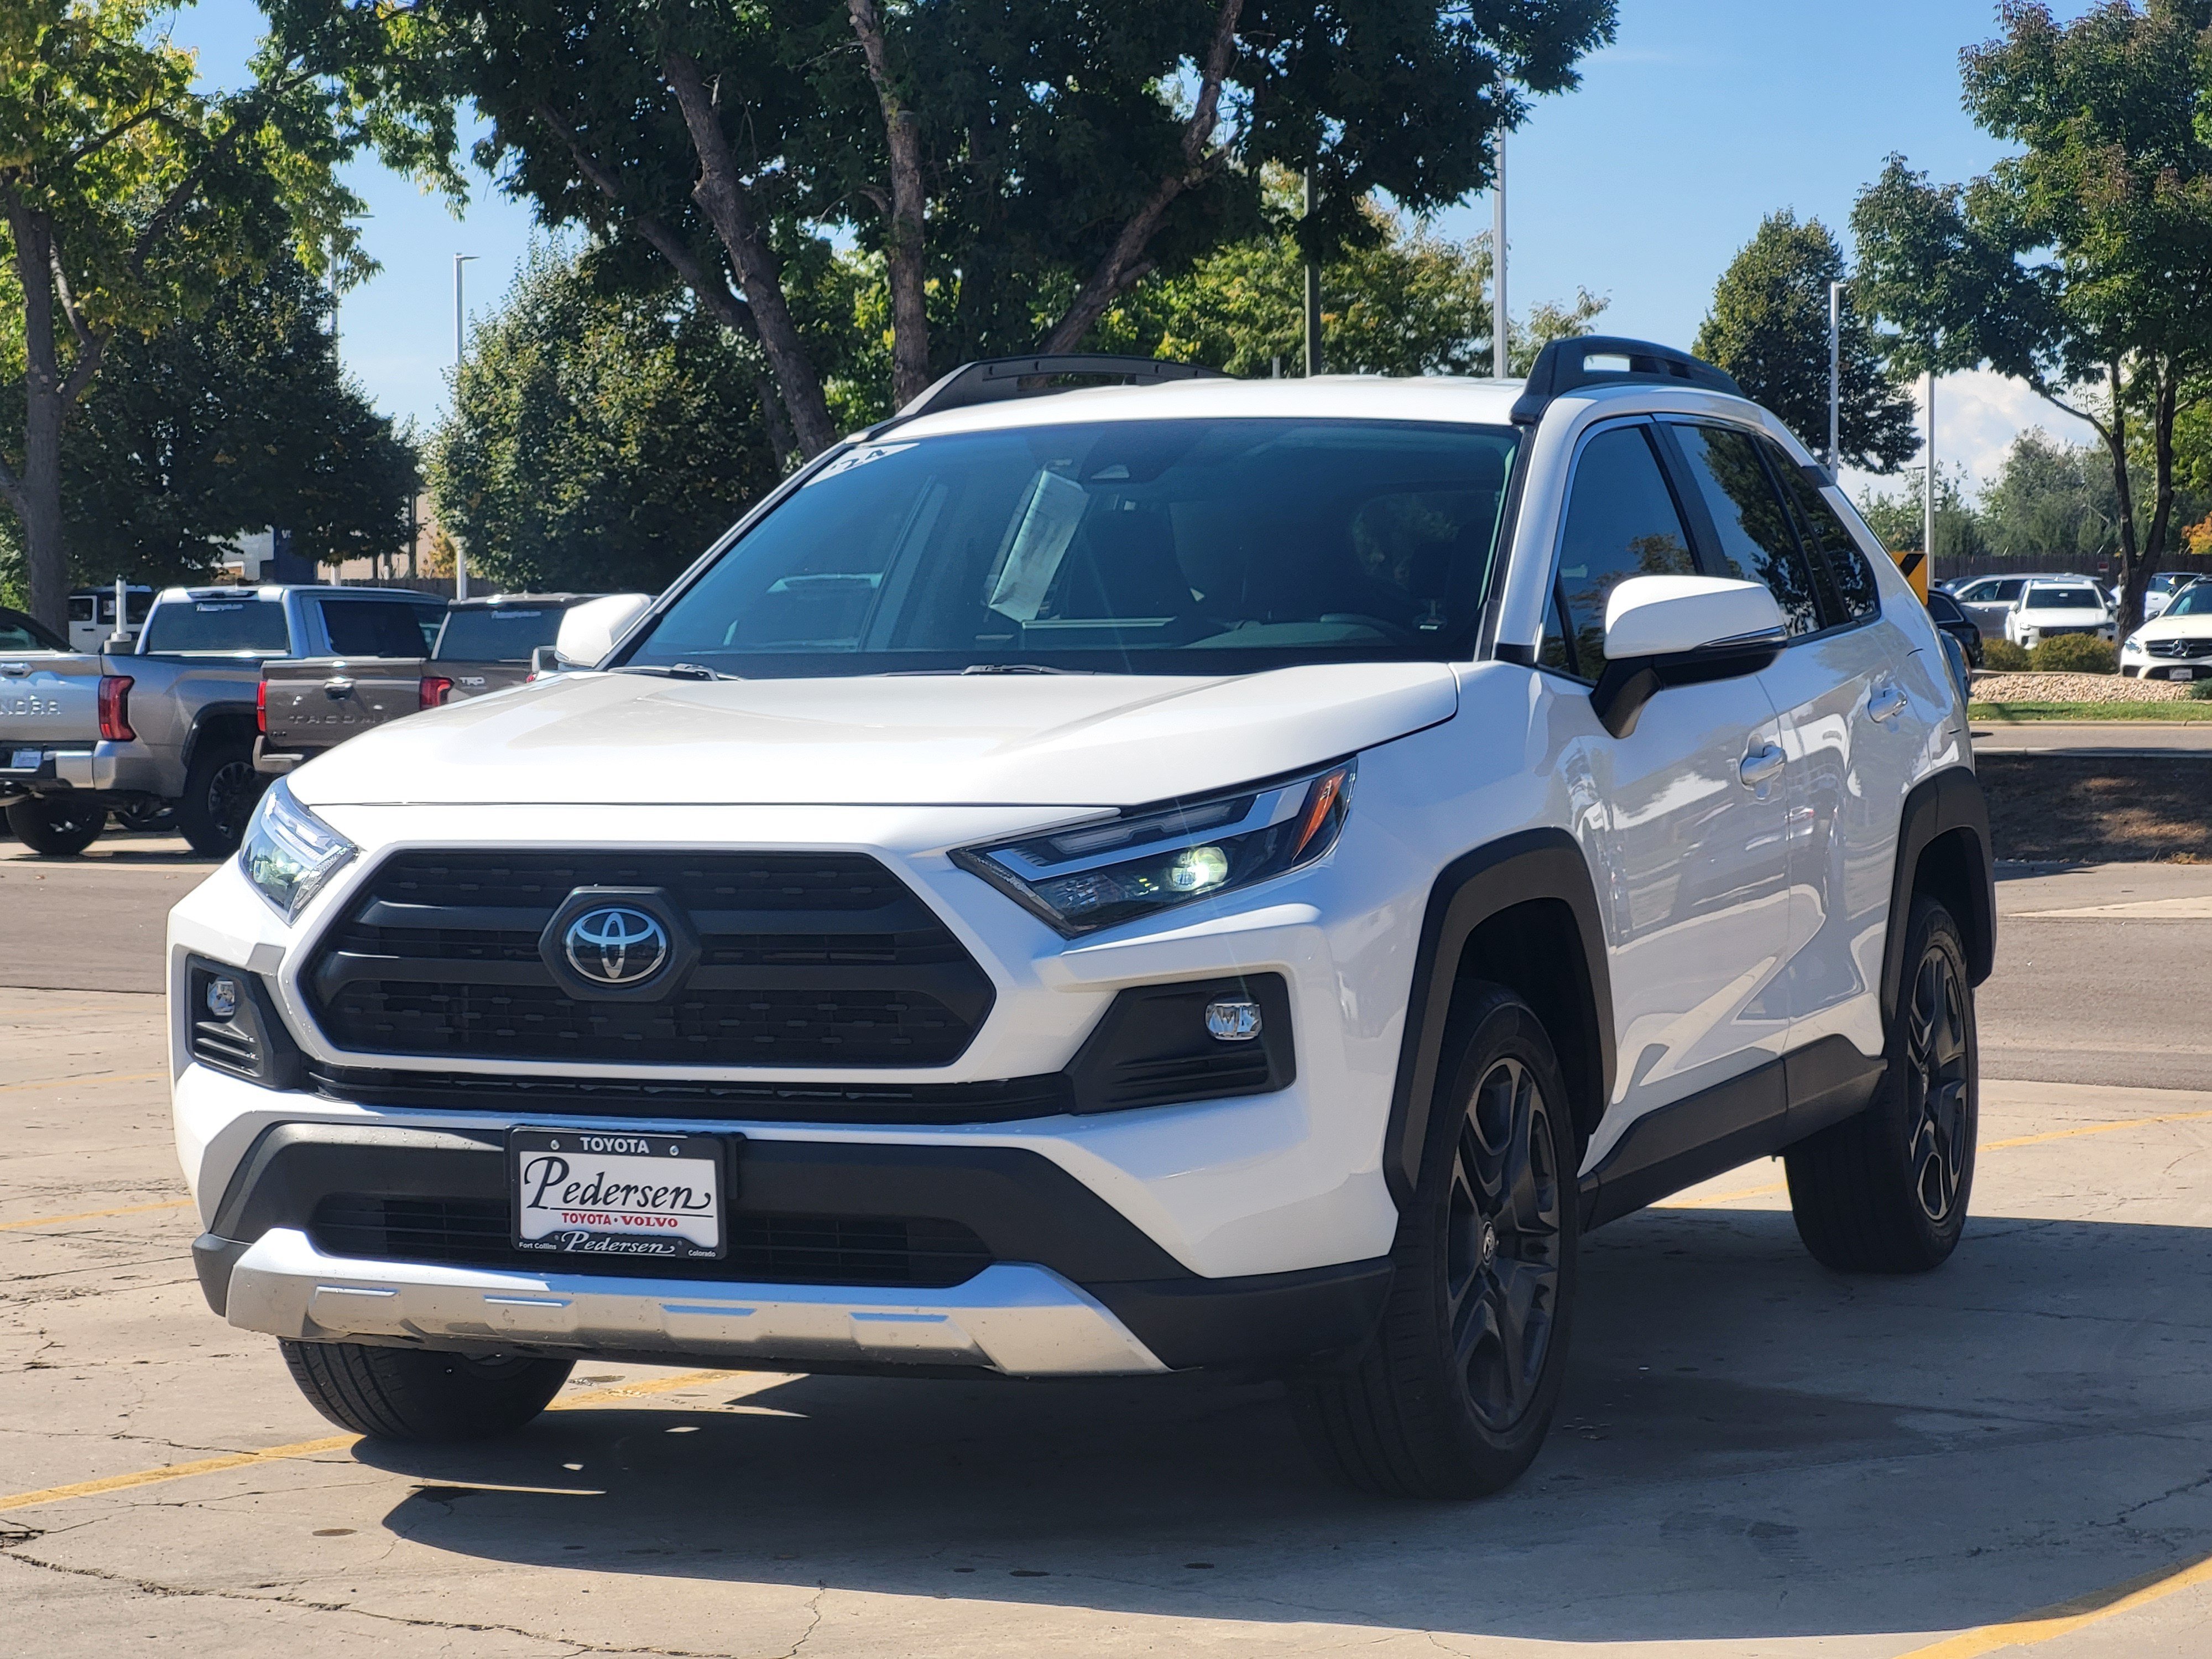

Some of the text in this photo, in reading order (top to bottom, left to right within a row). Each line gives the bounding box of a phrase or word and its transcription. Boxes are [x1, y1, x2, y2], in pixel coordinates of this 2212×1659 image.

[580, 1137, 650, 1154] TOYOTA
[524, 1156, 712, 1210] Pedersen
[561, 1213, 678, 1228] TOYOTA VOLVO
[561, 1231, 675, 1254] Pedersen
[688, 1249, 717, 1258] Colorado
